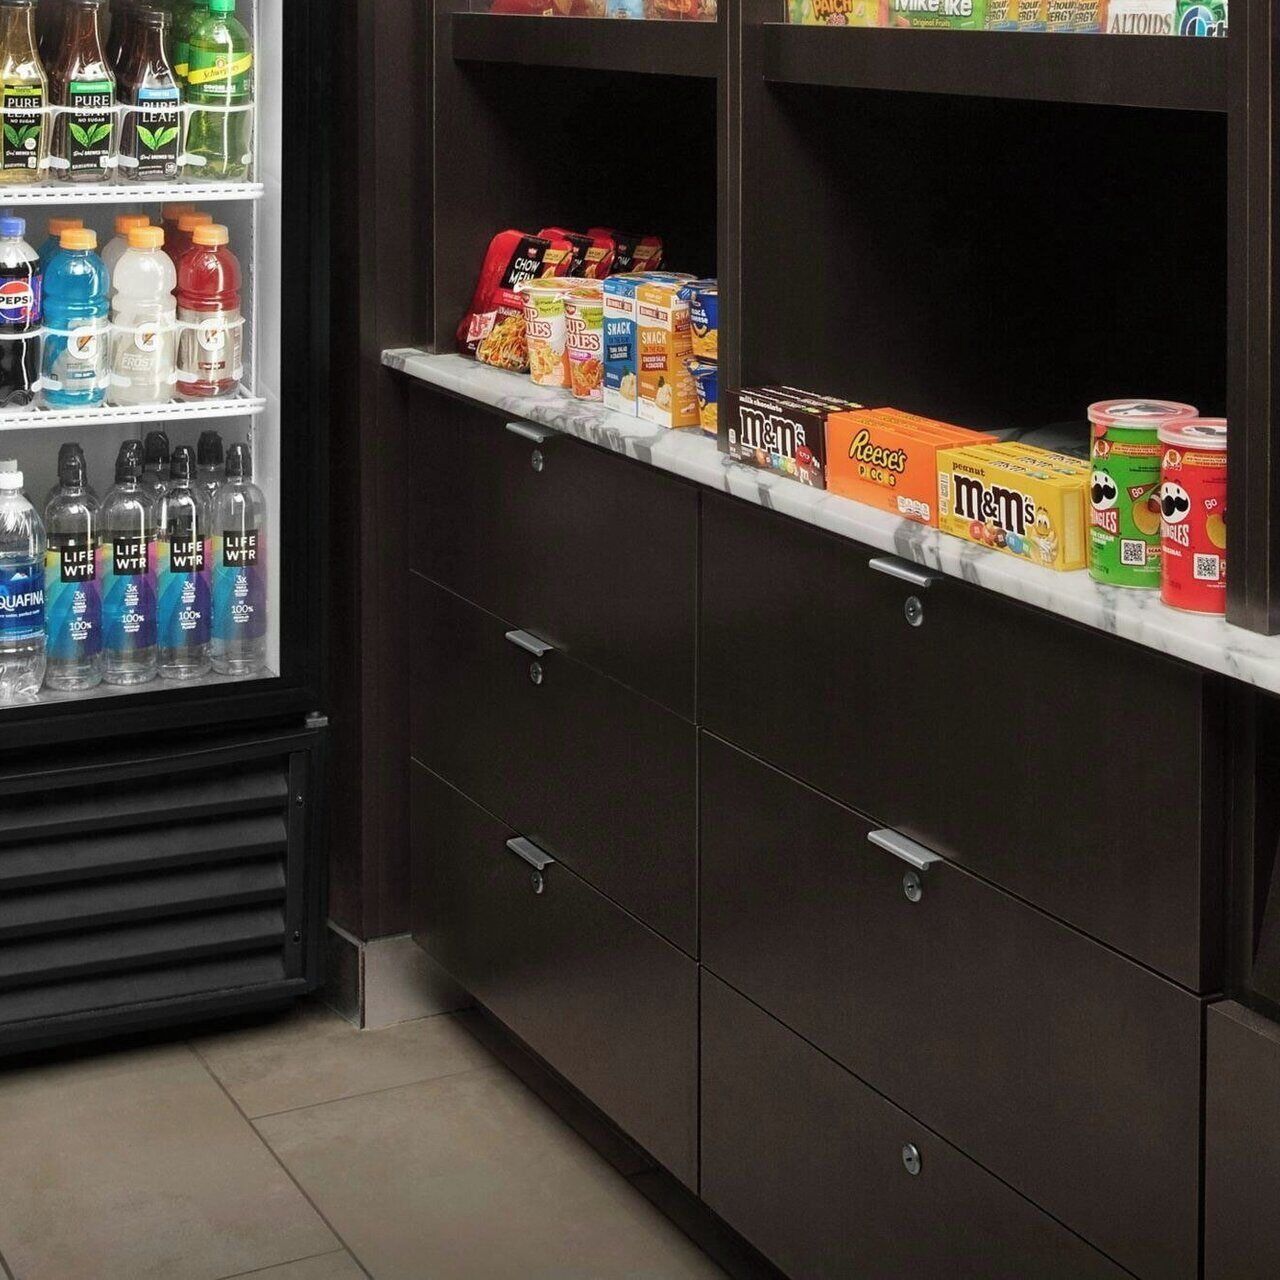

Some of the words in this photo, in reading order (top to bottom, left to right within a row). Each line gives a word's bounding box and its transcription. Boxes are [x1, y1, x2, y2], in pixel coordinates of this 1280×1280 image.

[1111, 13, 1170, 34] ALTOIDS
[7, 98, 39, 108] PURE
[75, 95, 109, 106] PURE
[514, 257, 540, 271] CHOW
[607, 322, 631, 335] SNACK
[642, 331, 667, 344] SNACK
[739, 395, 752, 404] milk
[753, 399, 783, 413] chocolate
[849, 429, 906, 473] Reese's
[952, 461, 985, 477] peanut
[64, 550, 94, 563] LIFE
[116, 544, 146, 556] LIFE
[64, 564, 94, 576] WTR
[116, 558, 146, 569] WTR
